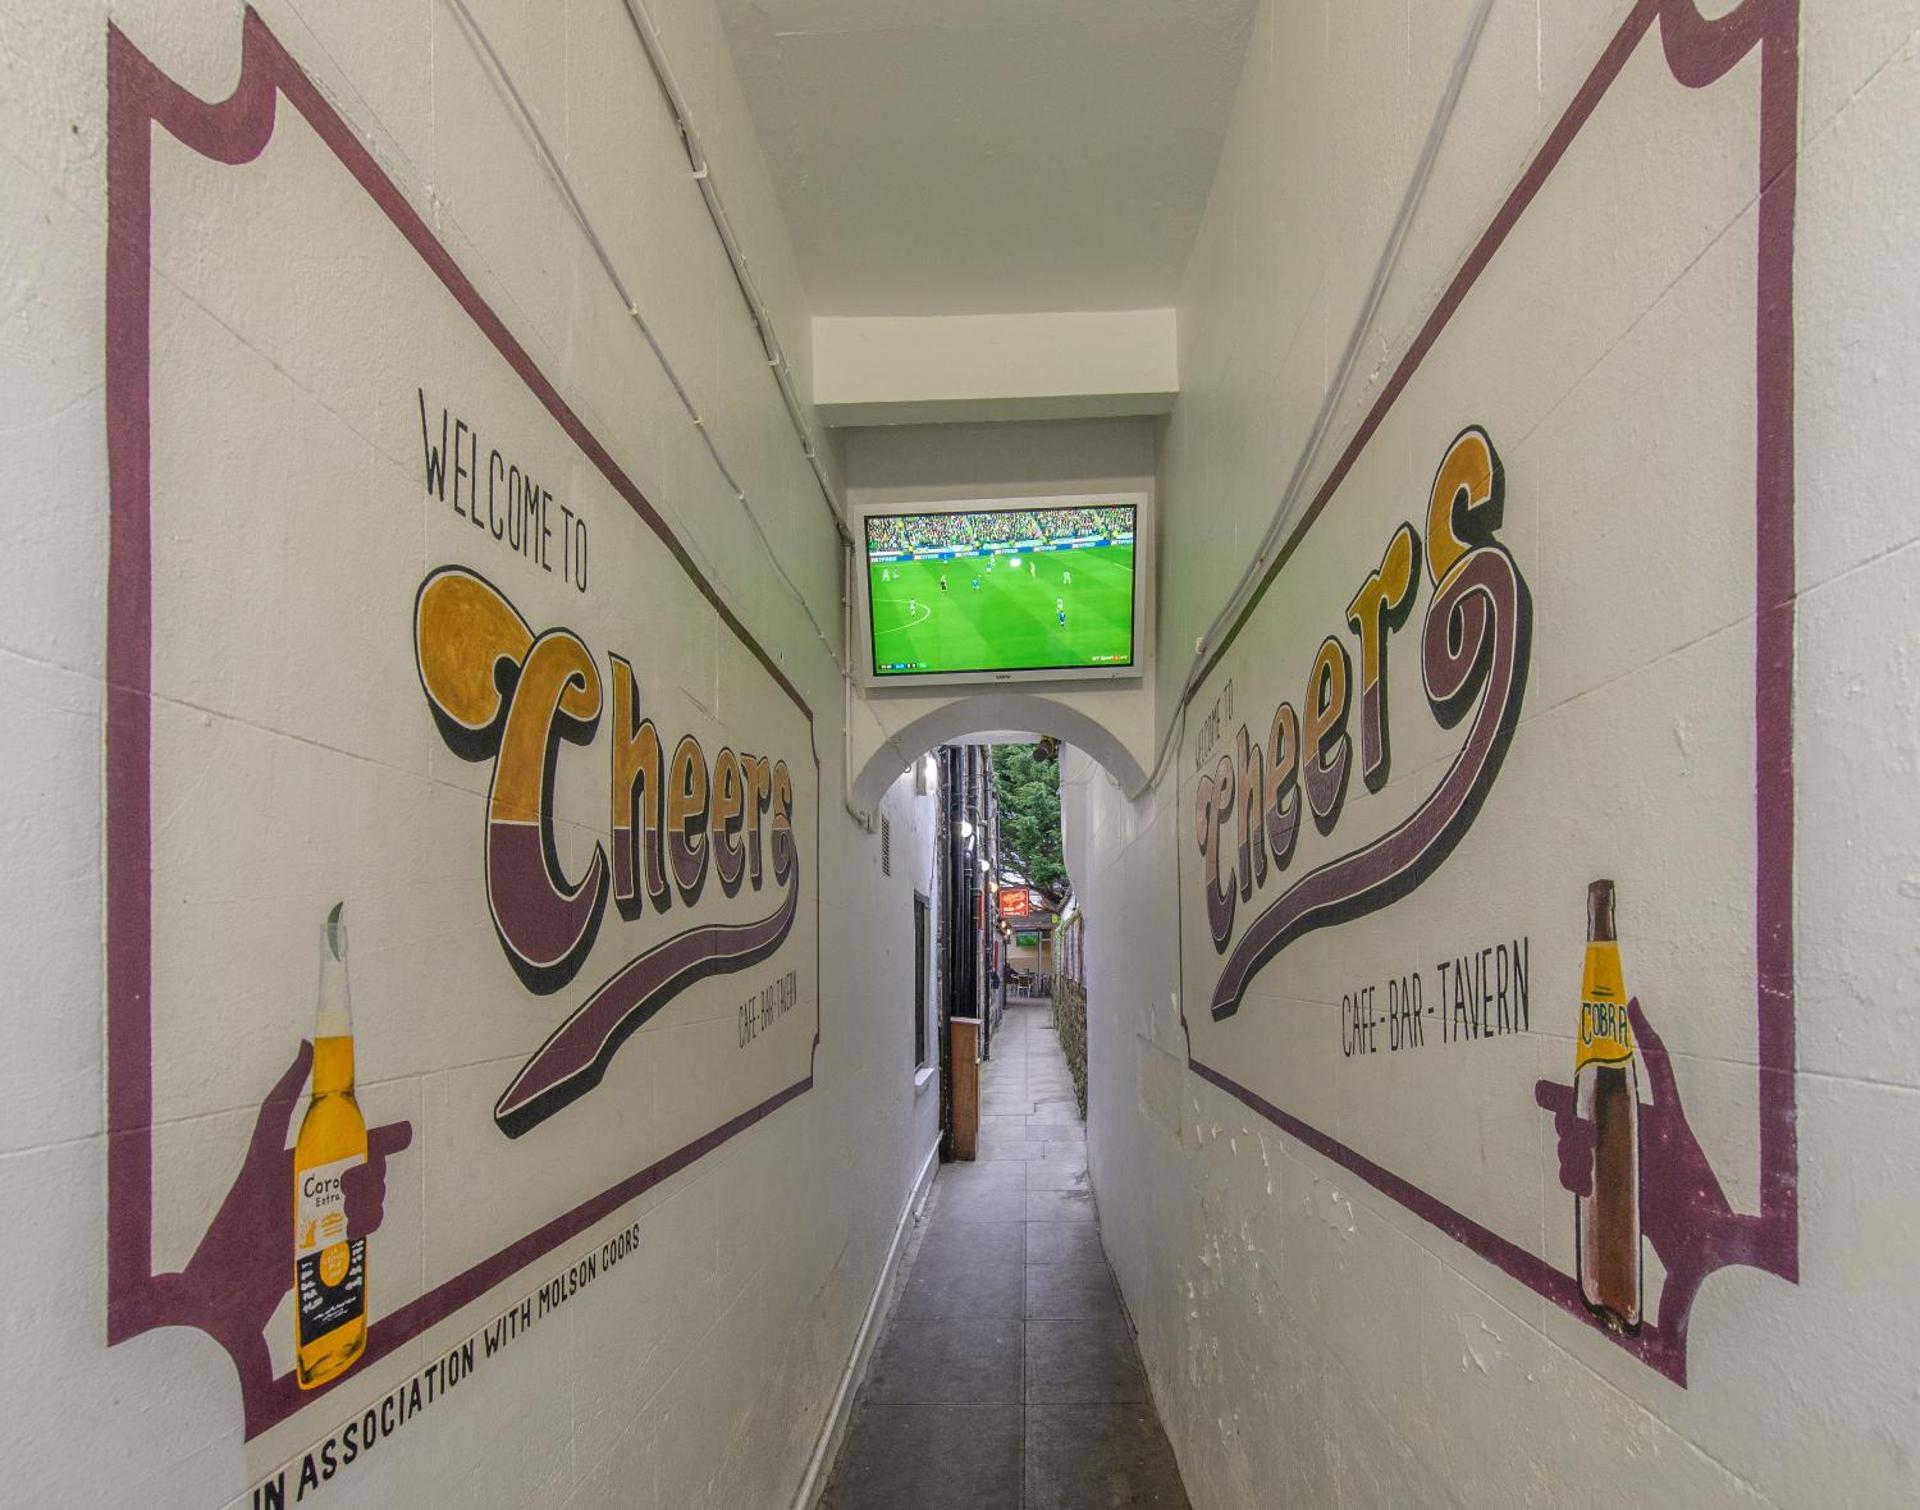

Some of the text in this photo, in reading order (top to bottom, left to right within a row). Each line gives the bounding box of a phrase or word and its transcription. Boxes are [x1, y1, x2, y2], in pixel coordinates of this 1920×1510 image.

[418, 387, 588, 594] WELCOME TO
[413, 564, 799, 1138] Cheers
[1196, 424, 1533, 1022] Cheers
[1581, 1002, 1629, 1050] COBRA
[297, 1338, 474, 1502] ASSOCIATION
[483, 1298, 532, 1359] WITH
[537, 1255, 597, 1319] MOLSON
[601, 1222, 641, 1272] COORS
